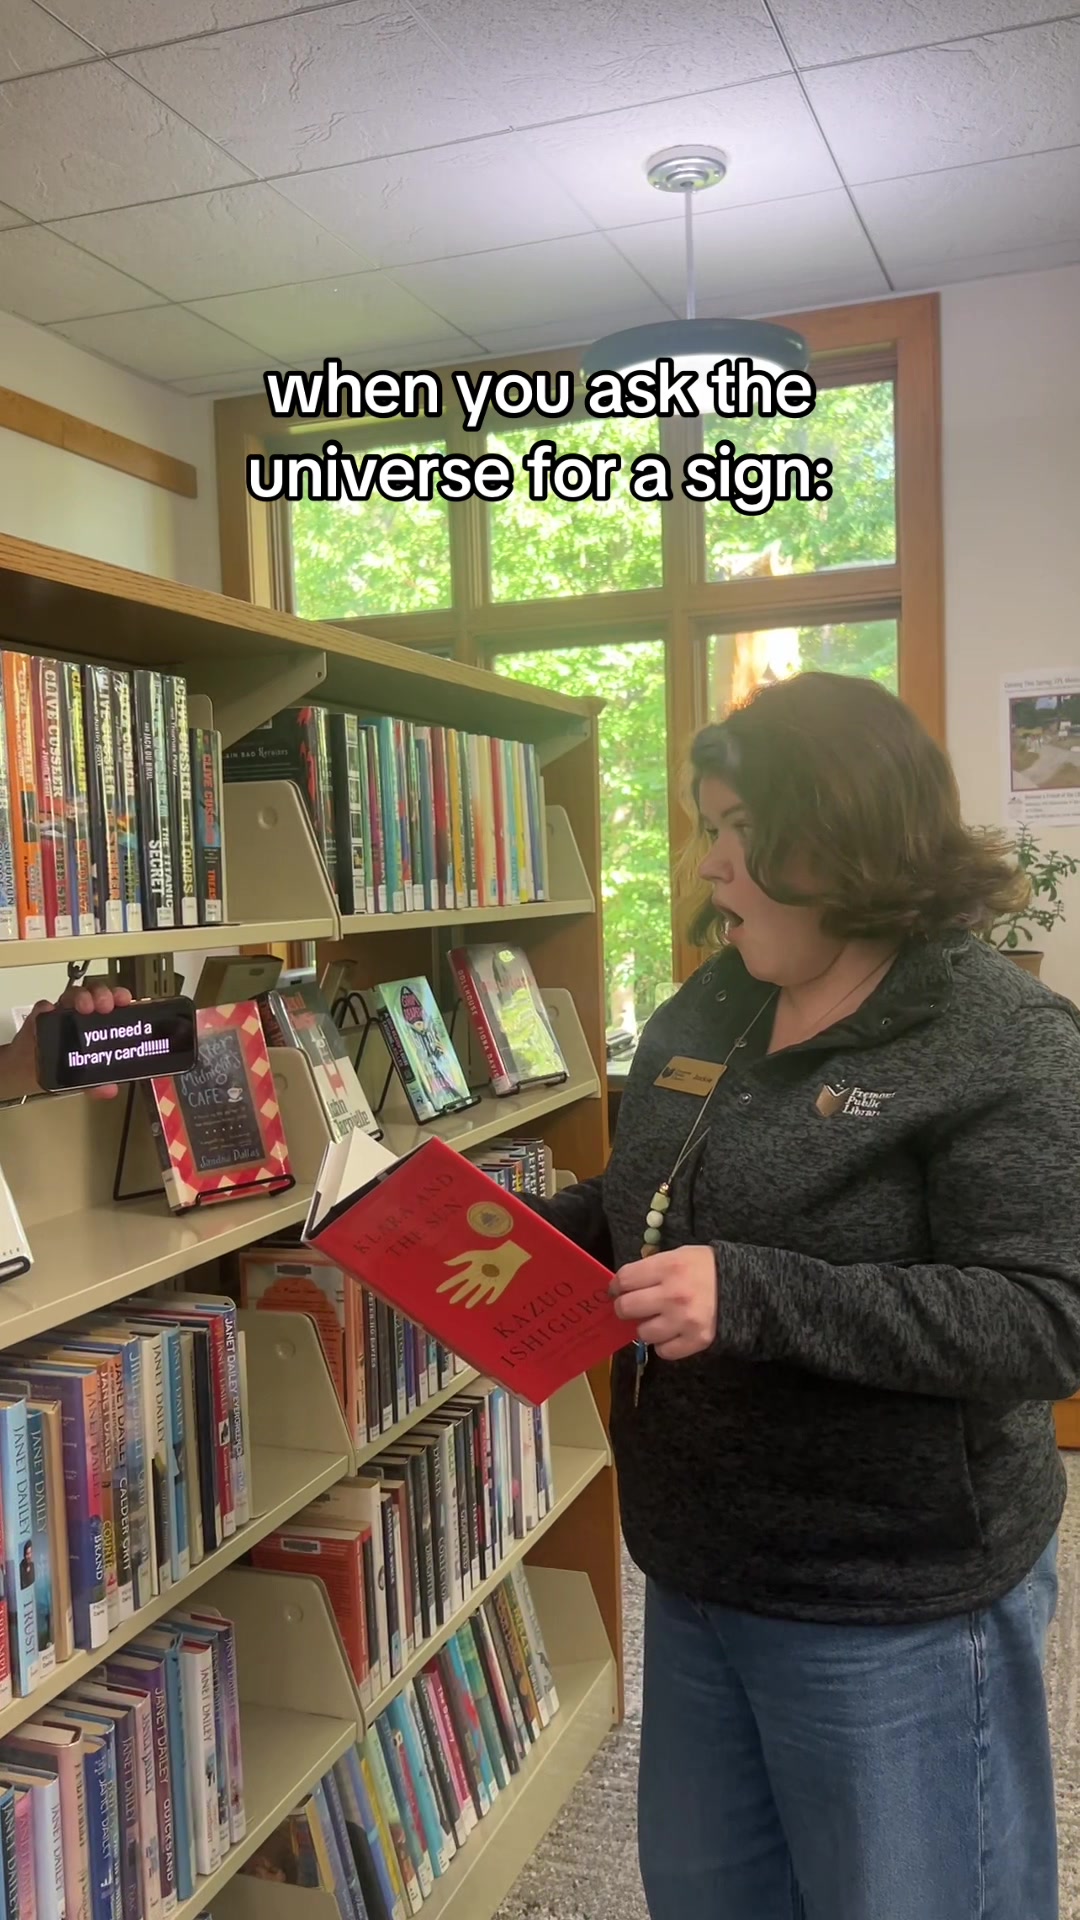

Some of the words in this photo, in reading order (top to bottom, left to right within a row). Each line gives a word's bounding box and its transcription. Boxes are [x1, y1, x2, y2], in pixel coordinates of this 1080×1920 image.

[44, 669, 60, 720] CLIVE
[71, 671, 83, 719] CLIVE
[97, 672, 112, 719] CLIVE
[174, 683, 188, 729] CLIVE
[48, 723, 64, 798] CUSSLER
[74, 722, 87, 793] CUSSLER
[101, 721, 116, 795] CUSSLER
[146, 761, 154, 780] BRUL
[177, 731, 192, 801] CUSSLER
[203, 753, 214, 788] CLIVE
[162, 827, 170, 847] THE
[181, 814, 191, 837] THE
[204, 791, 216, 845] CUSSLER
[149, 839, 166, 894] SECRET
[163, 853, 175, 909] TITANIC
[181, 839, 195, 895] TOMBS
[208, 869, 217, 901] TREAS
[84, 1029, 108, 1047] you
[110, 1020, 142, 1040] need
[143, 1022, 152, 1034] a
[458, 969, 479, 1016] DOLLHOUSE
[477, 1026, 490, 1050] FIONA
[486, 1054, 500, 1078] DAVIS
[68, 1050, 113, 1067] library
[181, 1049, 241, 1096] Midnight
[188, 1087, 222, 1108] CAFE
[845, 1095, 881, 1108] Public
[852, 1087, 896, 1099] Fremont
[537, 1147, 546, 1198] JEFFERY
[353, 1204, 415, 1255] KLARA
[418, 1173, 455, 1208] AND
[385, 1229, 424, 1260] THE
[426, 1200, 463, 1230] SUN
[493, 1280, 575, 1339] KAZUO
[500, 1287, 611, 1369] ISHIGURO
[216, 1340, 225, 1374] JANET
[225, 1318, 236, 1352] JANET
[153, 1344, 163, 1388] JANET
[172, 1339, 181, 1379] JANET
[227, 1355, 239, 1394] DAILEY
[101, 1371, 111, 1421] JANET
[114, 1362, 124, 1414] JANET
[176, 1386, 184, 1436] DAILEY
[219, 1378, 230, 1422] DAILEY
[86, 1391, 98, 1438] JANET
[156, 1391, 167, 1443] DAILEY
[13, 1424, 27, 1475] JANET
[31, 1429, 44, 1476] JANET
[103, 1423, 112, 1472] DAILEY
[117, 1416, 126, 1471] DAILEY
[90, 1443, 102, 1499] DAILEY
[433, 1446, 441, 1497] DEKKER
[17, 1479, 31, 1536] DAILEY
[35, 1480, 48, 1534] DAILEY
[120, 1476, 131, 1536] CALDER
[94, 1534, 105, 1581] BRAND
[121, 1539, 132, 1571] GRIT
[23, 1599, 35, 1656] TRUST
[223, 1636, 234, 1669] JANET
[200, 1667, 209, 1701] JANET
[227, 1671, 237, 1709] DAILEY
[154, 1687, 166, 1730] JANET
[202, 1703, 213, 1742] DAILEY
[141, 1711, 152, 1754] JANET
[122, 1736, 134, 1777] JANET
[157, 1732, 170, 1784] DAILEY
[99, 1778, 109, 1815] JANET
[124, 1779, 136, 1822] DAILEY
[2, 1800, 16, 1852] JANET
[20, 1811, 30, 1857] JANET
[51, 1803, 61, 1844] JANET
[101, 1816, 112, 1859] DAILEY
[163, 1798, 175, 1882] QUICKSAND
[7, 1855, 18, 1914] DAILEY
[54, 1846, 64, 1892] DAILEY
